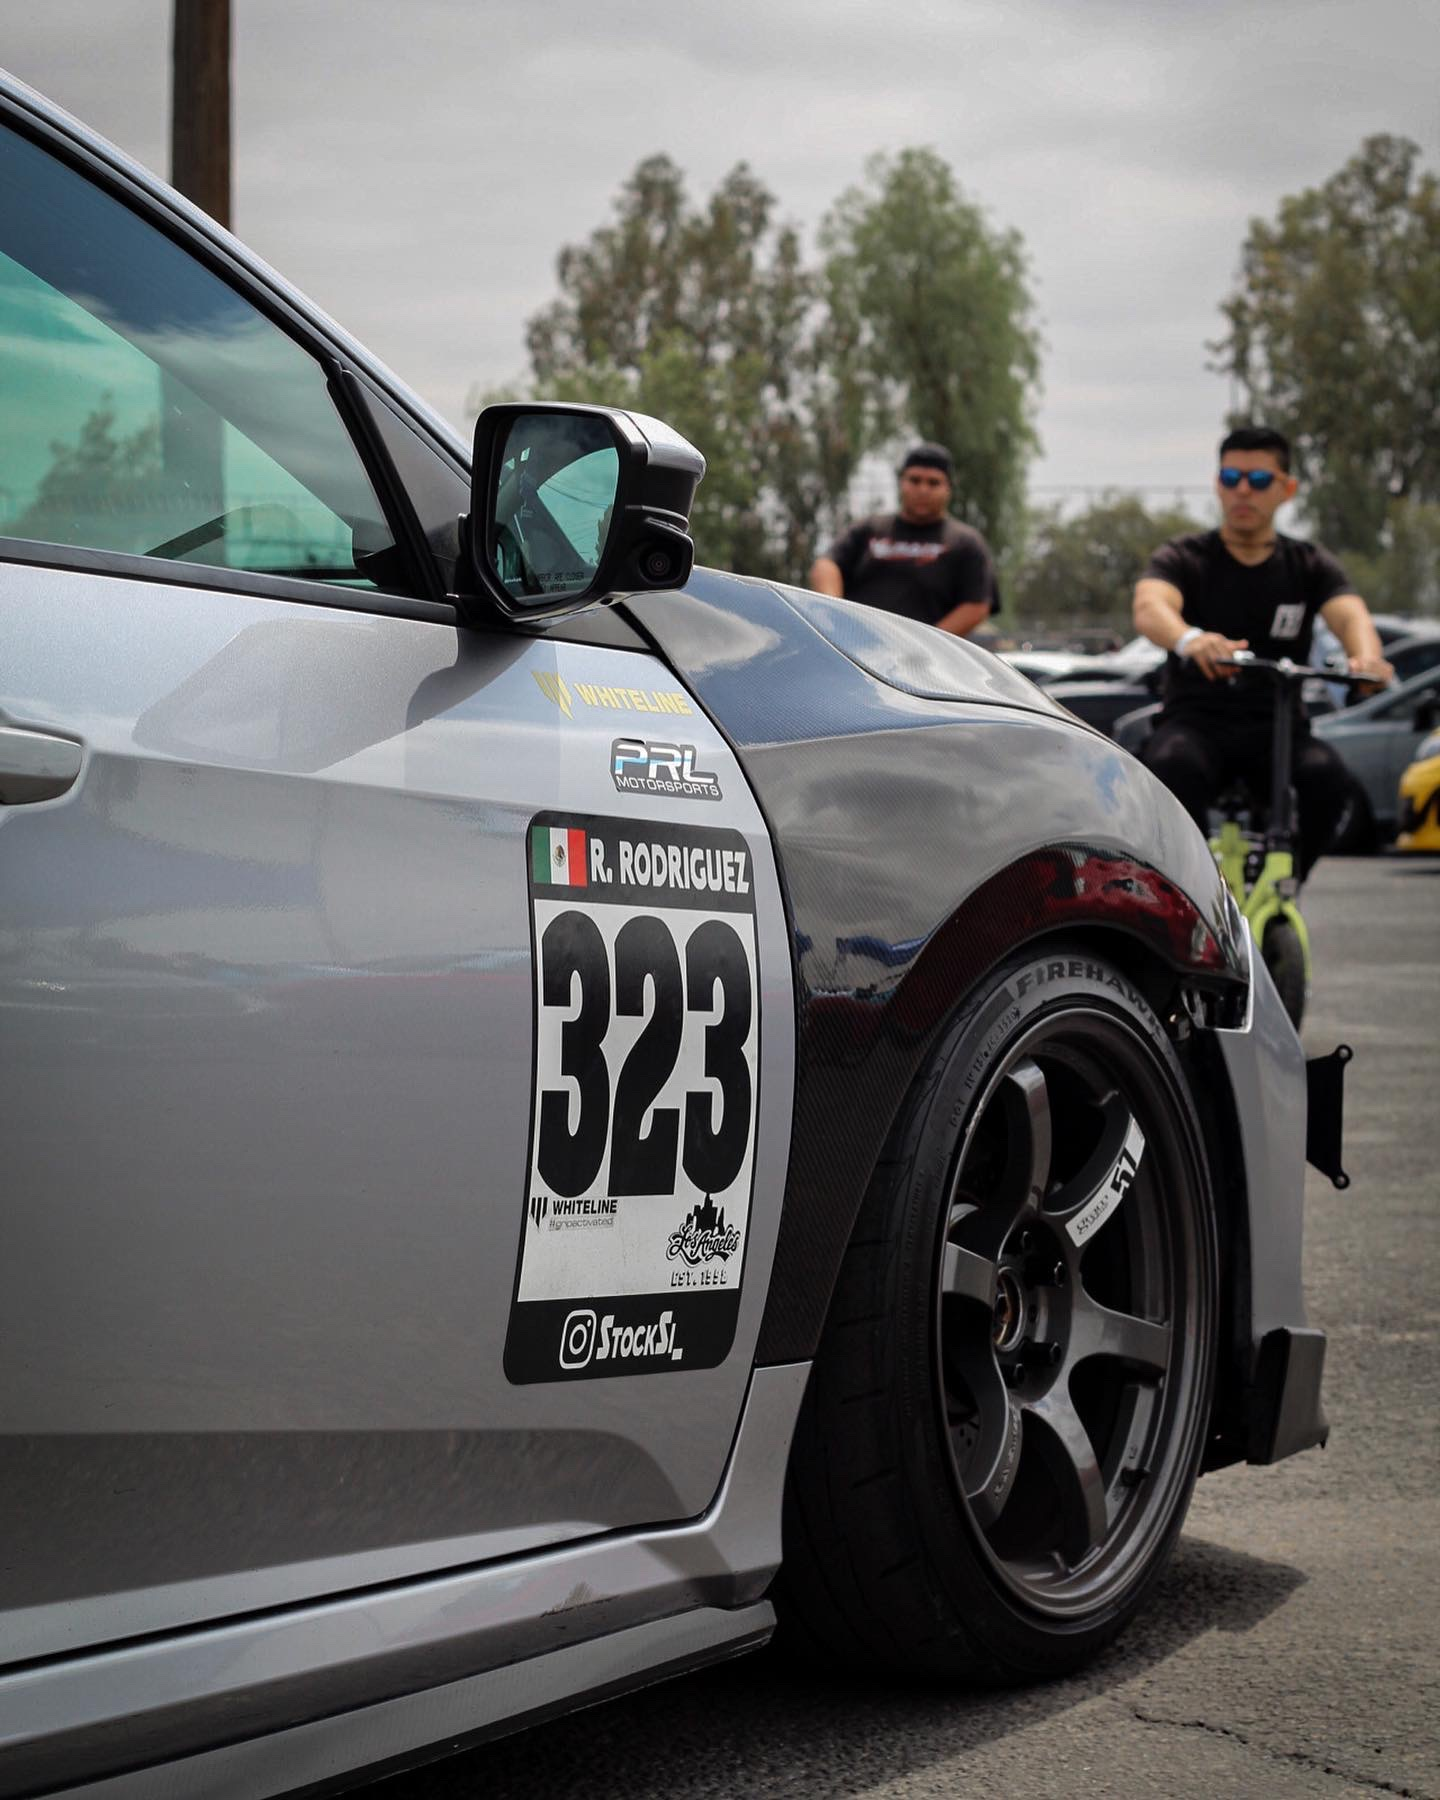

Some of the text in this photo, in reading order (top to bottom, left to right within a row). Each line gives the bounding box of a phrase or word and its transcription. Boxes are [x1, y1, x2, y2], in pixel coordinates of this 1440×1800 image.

[573, 683, 693, 717] WHITELINE
[614, 743, 715, 784] PRL
[615, 775, 720, 796] MOTORSPORTS
[590, 838, 750, 894] R. RODRIGUEZ
[537, 910, 752, 1198] 323
[552, 1199, 618, 1216] WHITELINE
[691, 1224, 741, 1262] Angeles
